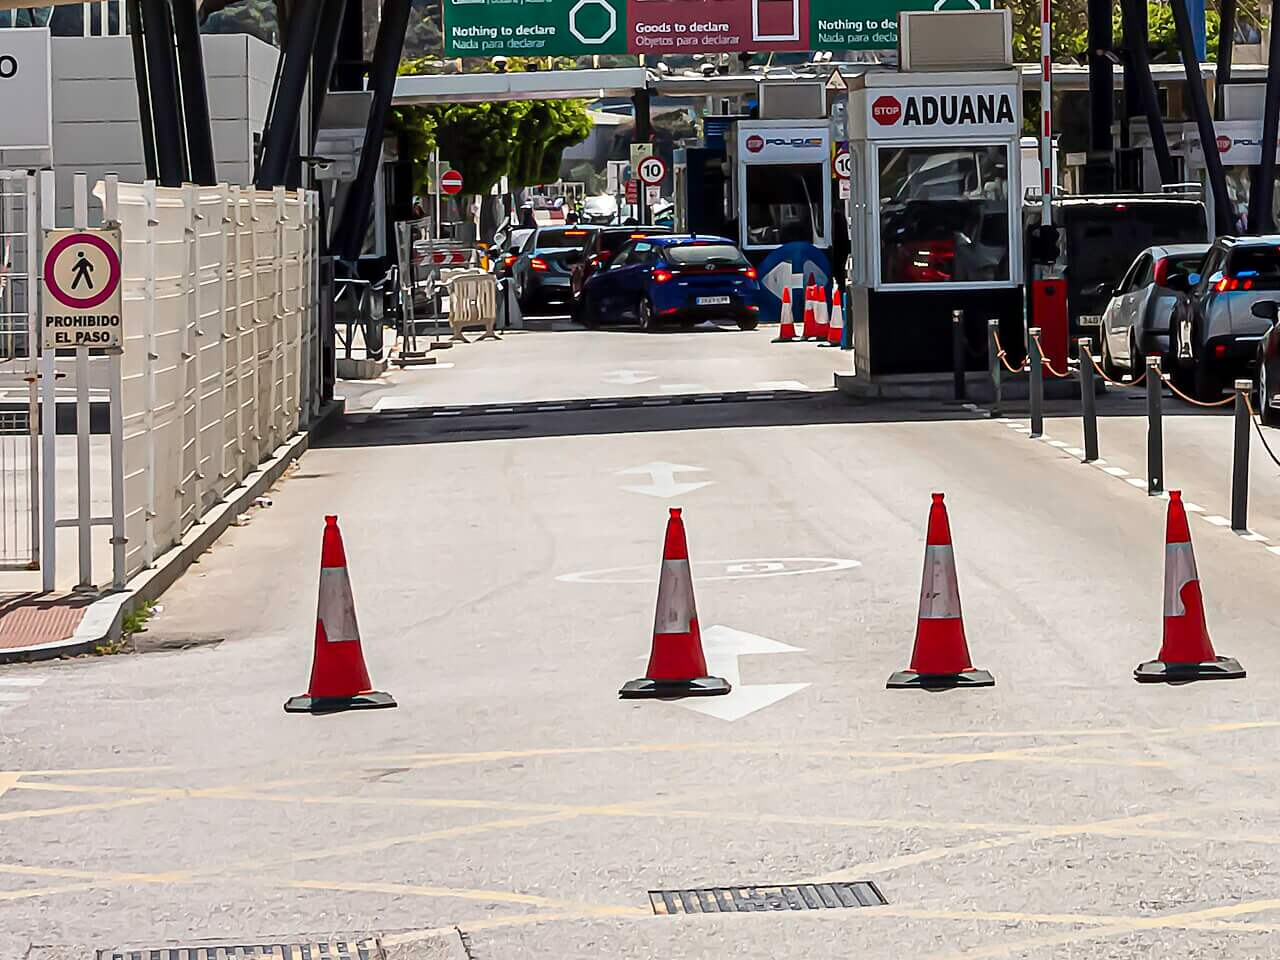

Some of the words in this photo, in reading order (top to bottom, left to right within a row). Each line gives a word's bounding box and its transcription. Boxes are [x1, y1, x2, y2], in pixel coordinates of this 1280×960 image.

[452, 25, 497, 38] Nothing
[501, 26, 513, 35] to
[516, 25, 555, 35] declare
[635, 22, 671, 33] Goods
[674, 23, 686, 32] to
[689, 22, 729, 32] declare
[818, 19, 862, 32] Nothing
[866, 20, 878, 29] to
[636, 36, 673, 48] Objetos
[676, 37, 698, 46] para
[818, 32, 844, 43] Nada
[848, 33, 869, 44] para
[872, 32, 898, 42] decla
[452, 39, 479, 49] Nada
[482, 40, 503, 50] para
[874, 107, 899, 115] STOP
[903, 95, 1014, 126] ADUANA
[643, 164, 661, 177] 10
[45, 315, 120, 327] PROHIBIDO
[55, 332, 71, 343] EL
[76, 331, 110, 343] PASO
